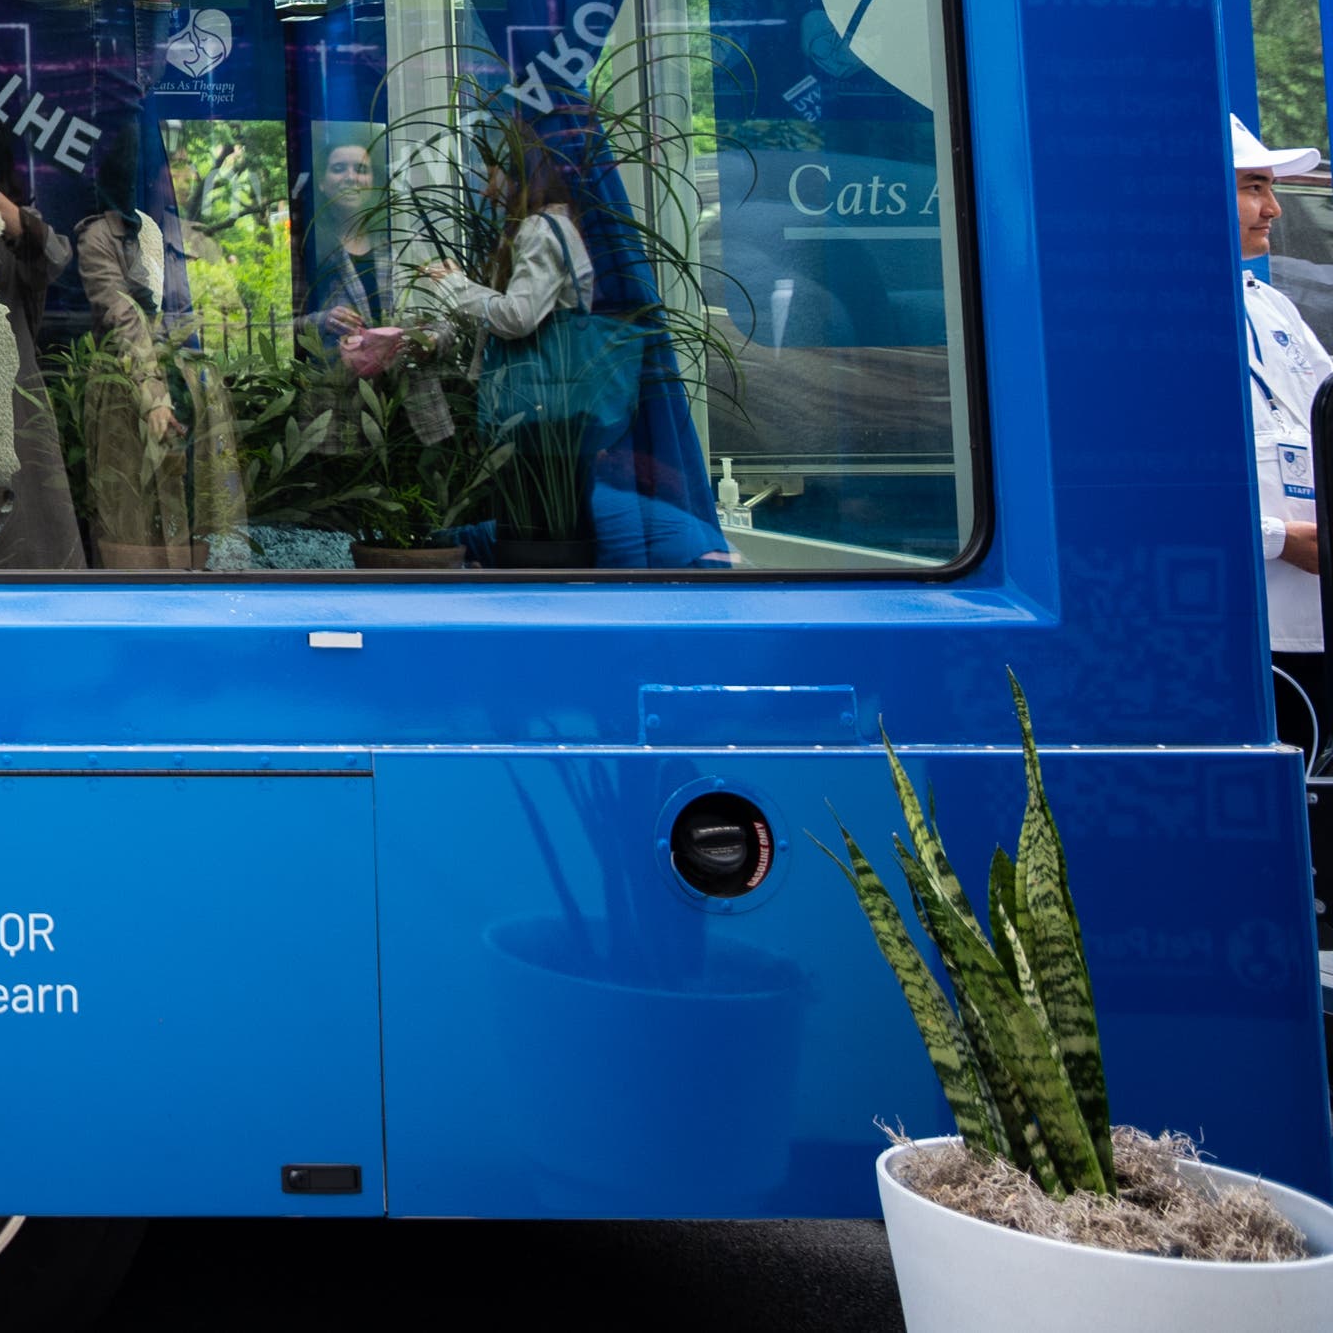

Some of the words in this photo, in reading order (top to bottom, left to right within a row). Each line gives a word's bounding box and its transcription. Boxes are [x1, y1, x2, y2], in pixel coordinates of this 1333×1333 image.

[192, 79, 235, 94] Therapy
[200, 91, 235, 104] Project
[788, 164, 907, 216] Cats
[1287, 485, 1312, 496] STAFF
[0, 913, 55, 957] QR
